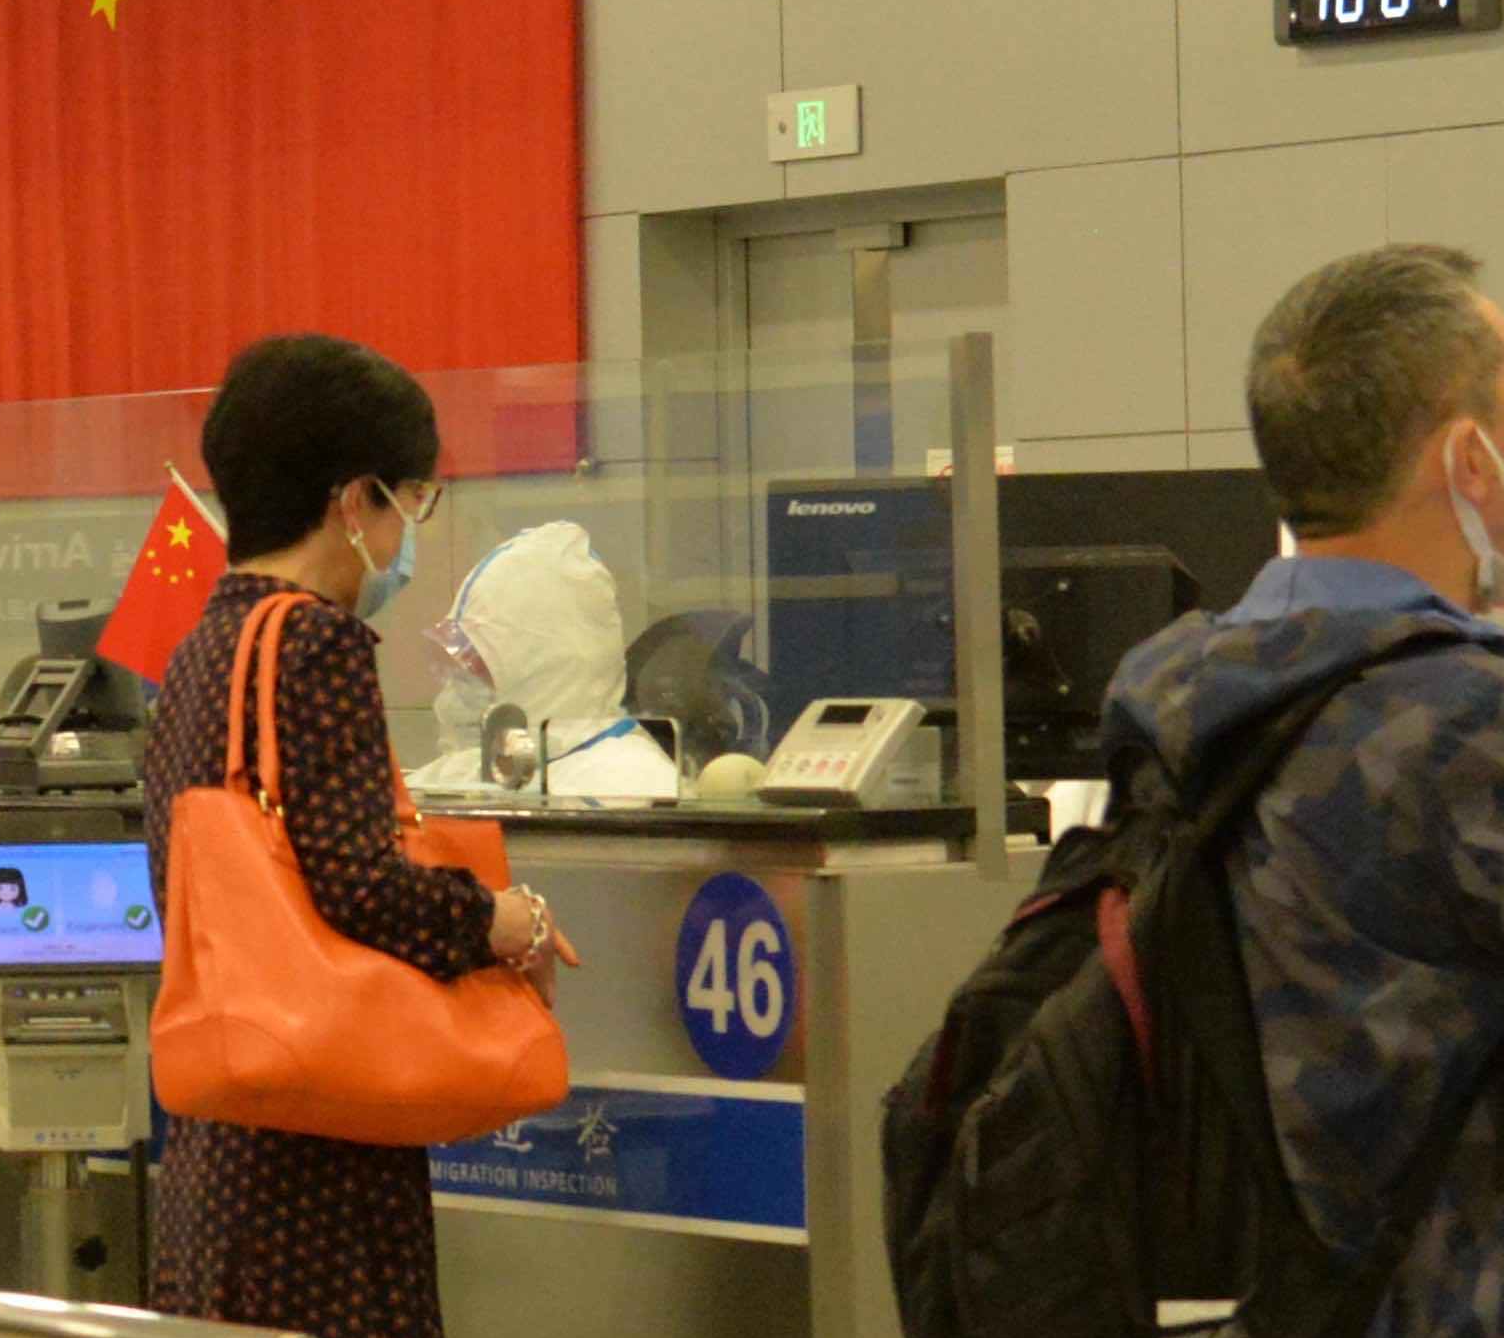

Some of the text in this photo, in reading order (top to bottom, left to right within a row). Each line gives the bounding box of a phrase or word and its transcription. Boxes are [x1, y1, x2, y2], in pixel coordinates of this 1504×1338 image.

[787, 500, 877, 517] lenovo
[686, 918, 785, 1039] 46
[429, 1158, 618, 1196] MIGRATION INSPECTION
